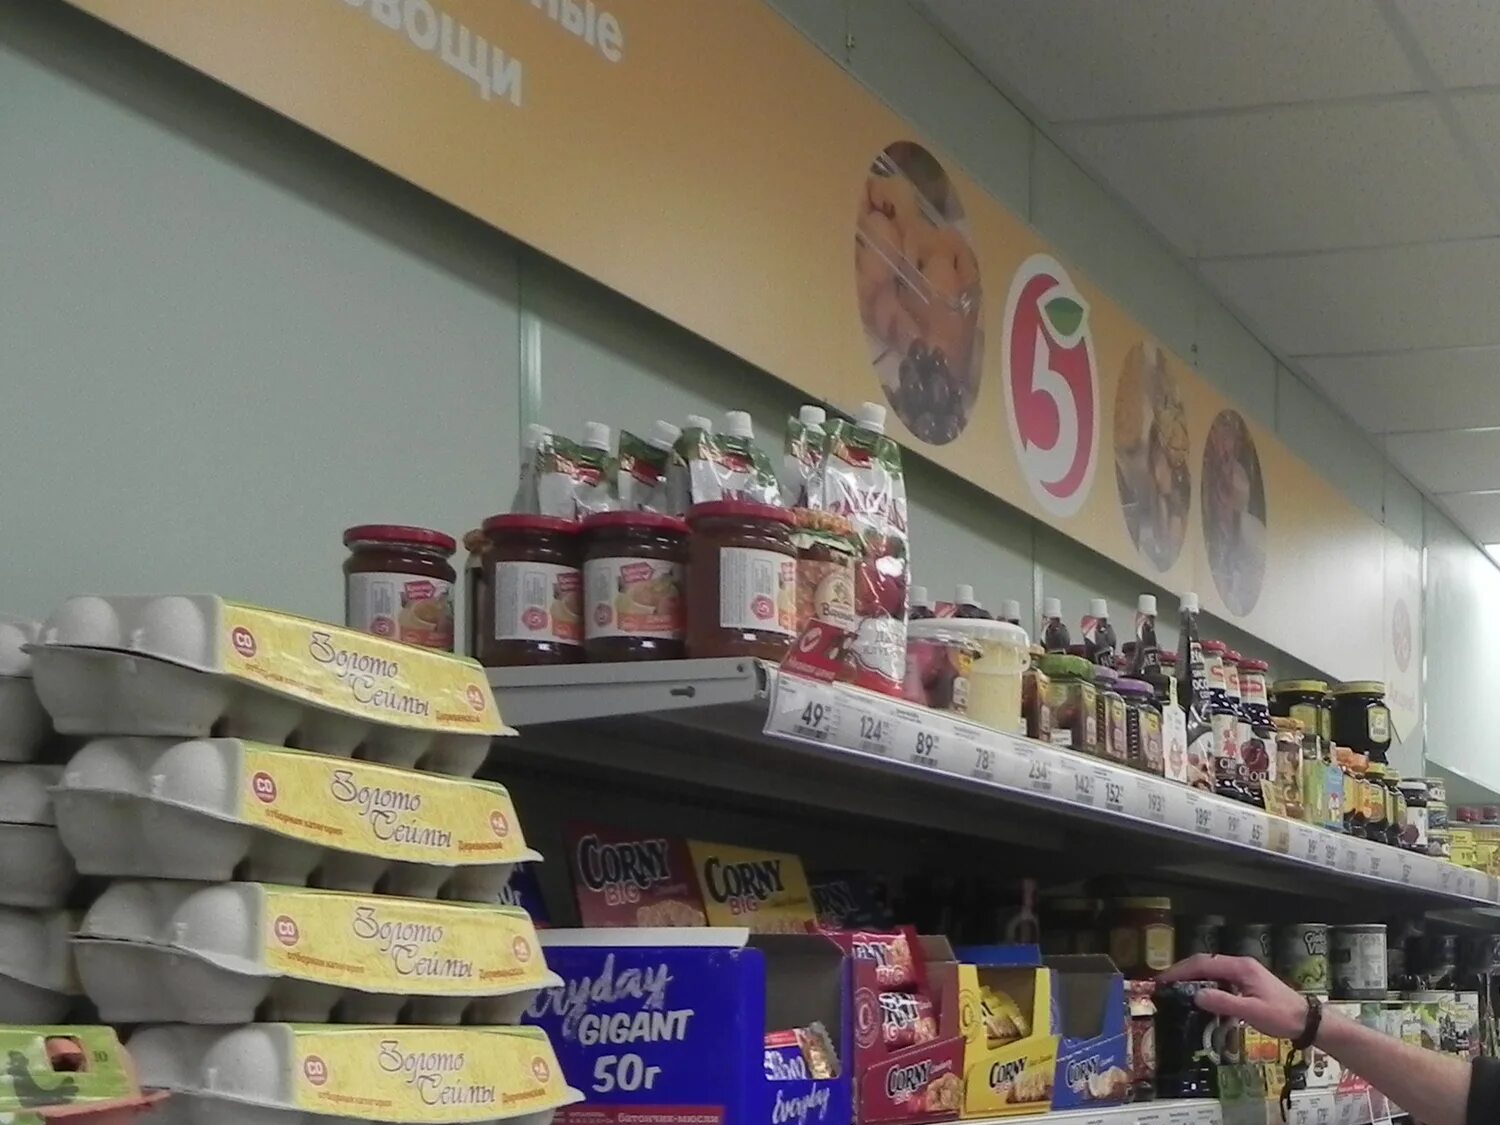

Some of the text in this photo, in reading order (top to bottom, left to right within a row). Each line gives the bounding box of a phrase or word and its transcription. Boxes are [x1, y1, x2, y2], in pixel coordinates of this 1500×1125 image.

[346, 0, 522, 106] вощи
[308, 630, 399, 679] Золото
[349, 672, 430, 717] Сеймы
[801, 701, 824, 727] 49
[860, 715, 882, 741] 124
[915, 731, 934, 755] 89
[331, 769, 421, 816] Золото
[370, 807, 452, 848] Сеймы
[578, 834, 670, 892] CORNY
[704, 856, 785, 904] CORNY
[604, 880, 640, 907] BIG
[729, 896, 758, 916] BIG
[353, 906, 443, 952] Золото
[390, 943, 474, 979] Сеймы
[576, 1008, 695, 1046] GIGANT
[378, 1039, 465, 1084] Золото
[886, 1058, 933, 1098] CORNY
[989, 1056, 1028, 1088] CORNY
[1065, 1054, 1101, 1087] CORNY
[416, 1073, 497, 1106] Сеймы
[617, 1111, 720, 1124] батончик-мюсли
